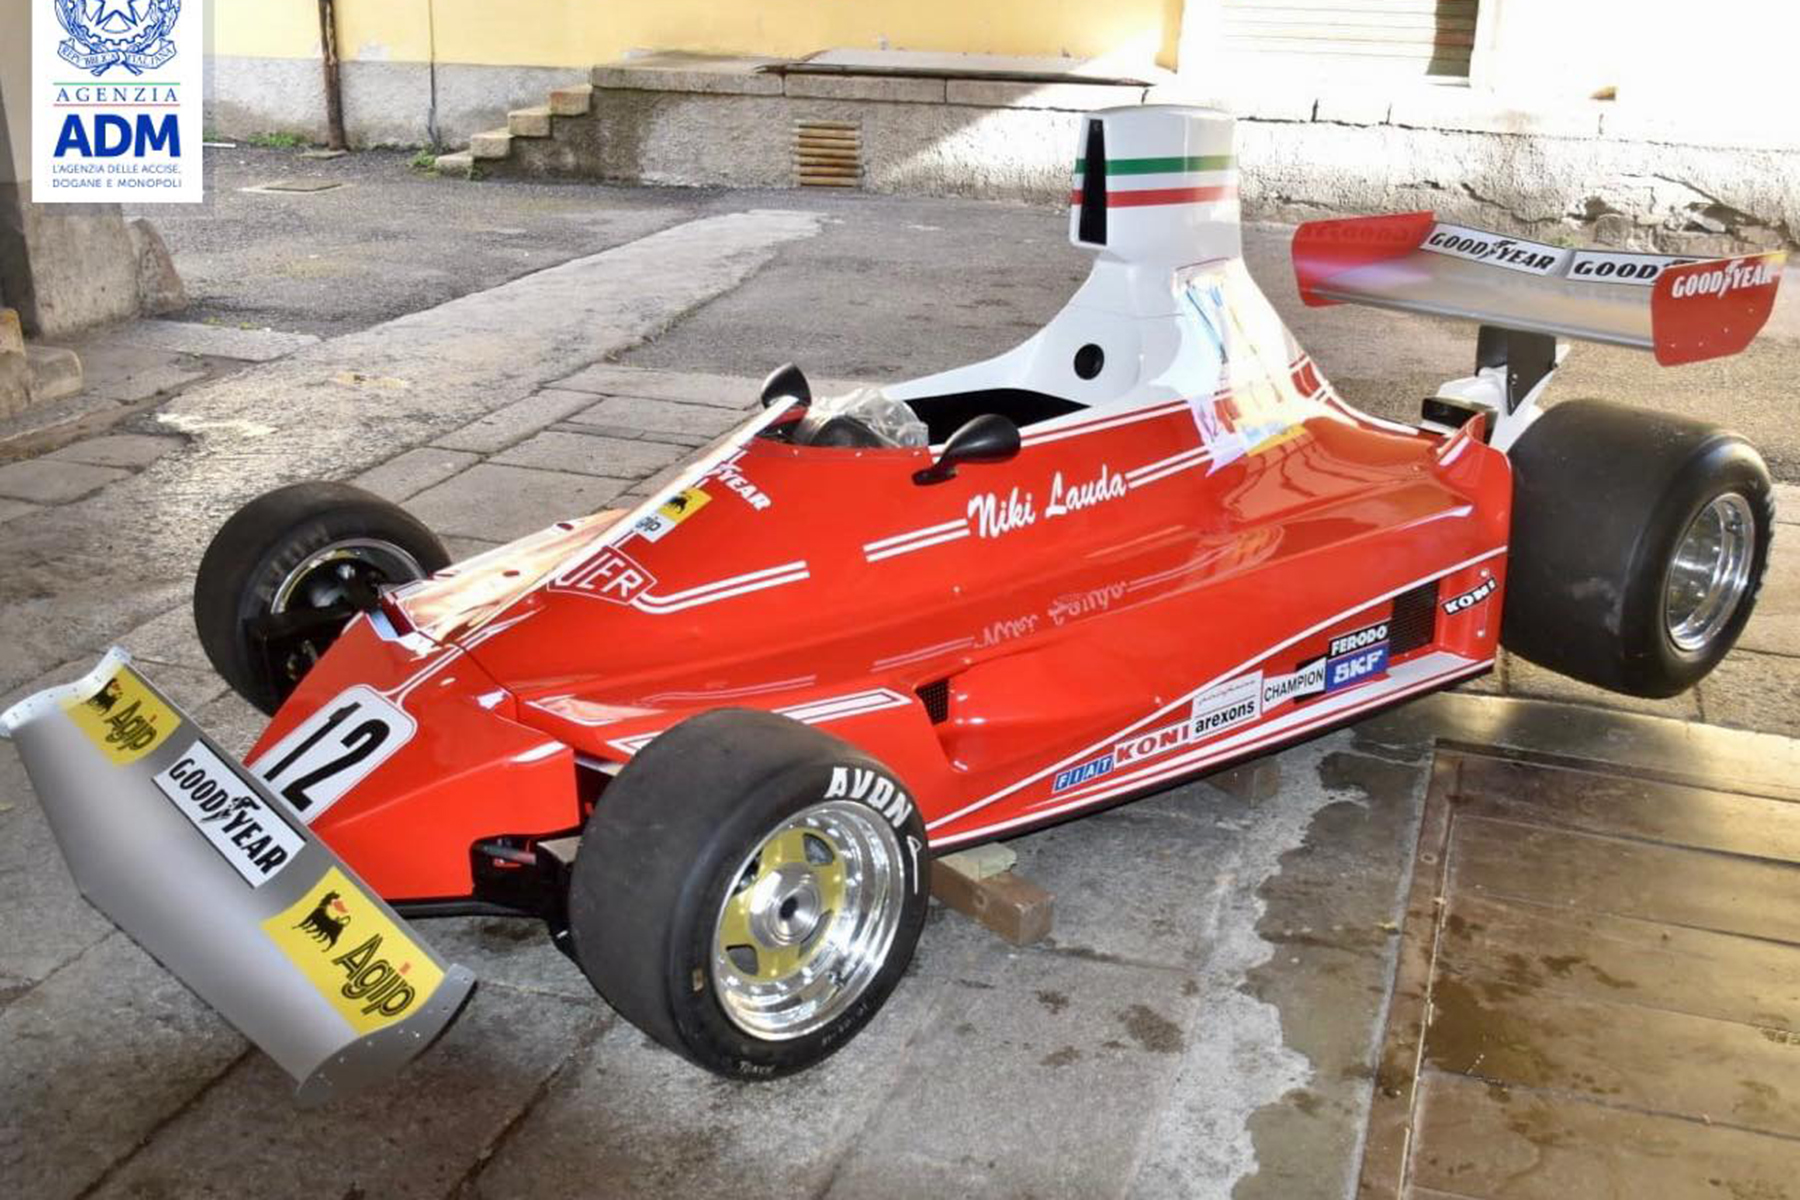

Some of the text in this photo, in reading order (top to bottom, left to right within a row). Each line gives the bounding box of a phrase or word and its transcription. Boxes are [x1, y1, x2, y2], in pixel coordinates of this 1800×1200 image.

[1428, 231, 1556, 271] GOODYEAR
[1574, 260, 1660, 279] GOOD
[1671, 259, 1779, 299] GOODYEAR
[717, 464, 772, 511] YEAR
[967, 464, 1128, 538] Niki Lauda
[555, 551, 645, 598] UER
[1445, 578, 1496, 615] KONI
[1331, 624, 1388, 656] FERODO
[1264, 666, 1324, 703] CHAMPION
[1333, 649, 1384, 685] SKF
[105, 700, 157, 751] Agip
[1195, 700, 1255, 734] arexons
[263, 702, 391, 812] 12
[1116, 724, 1190, 764] KONI
[1056, 757, 1114, 789] FIAT
[168, 758, 289, 874] GOODYEAR
[823, 766, 913, 829] AVON
[333, 934, 416, 1018] Agip
